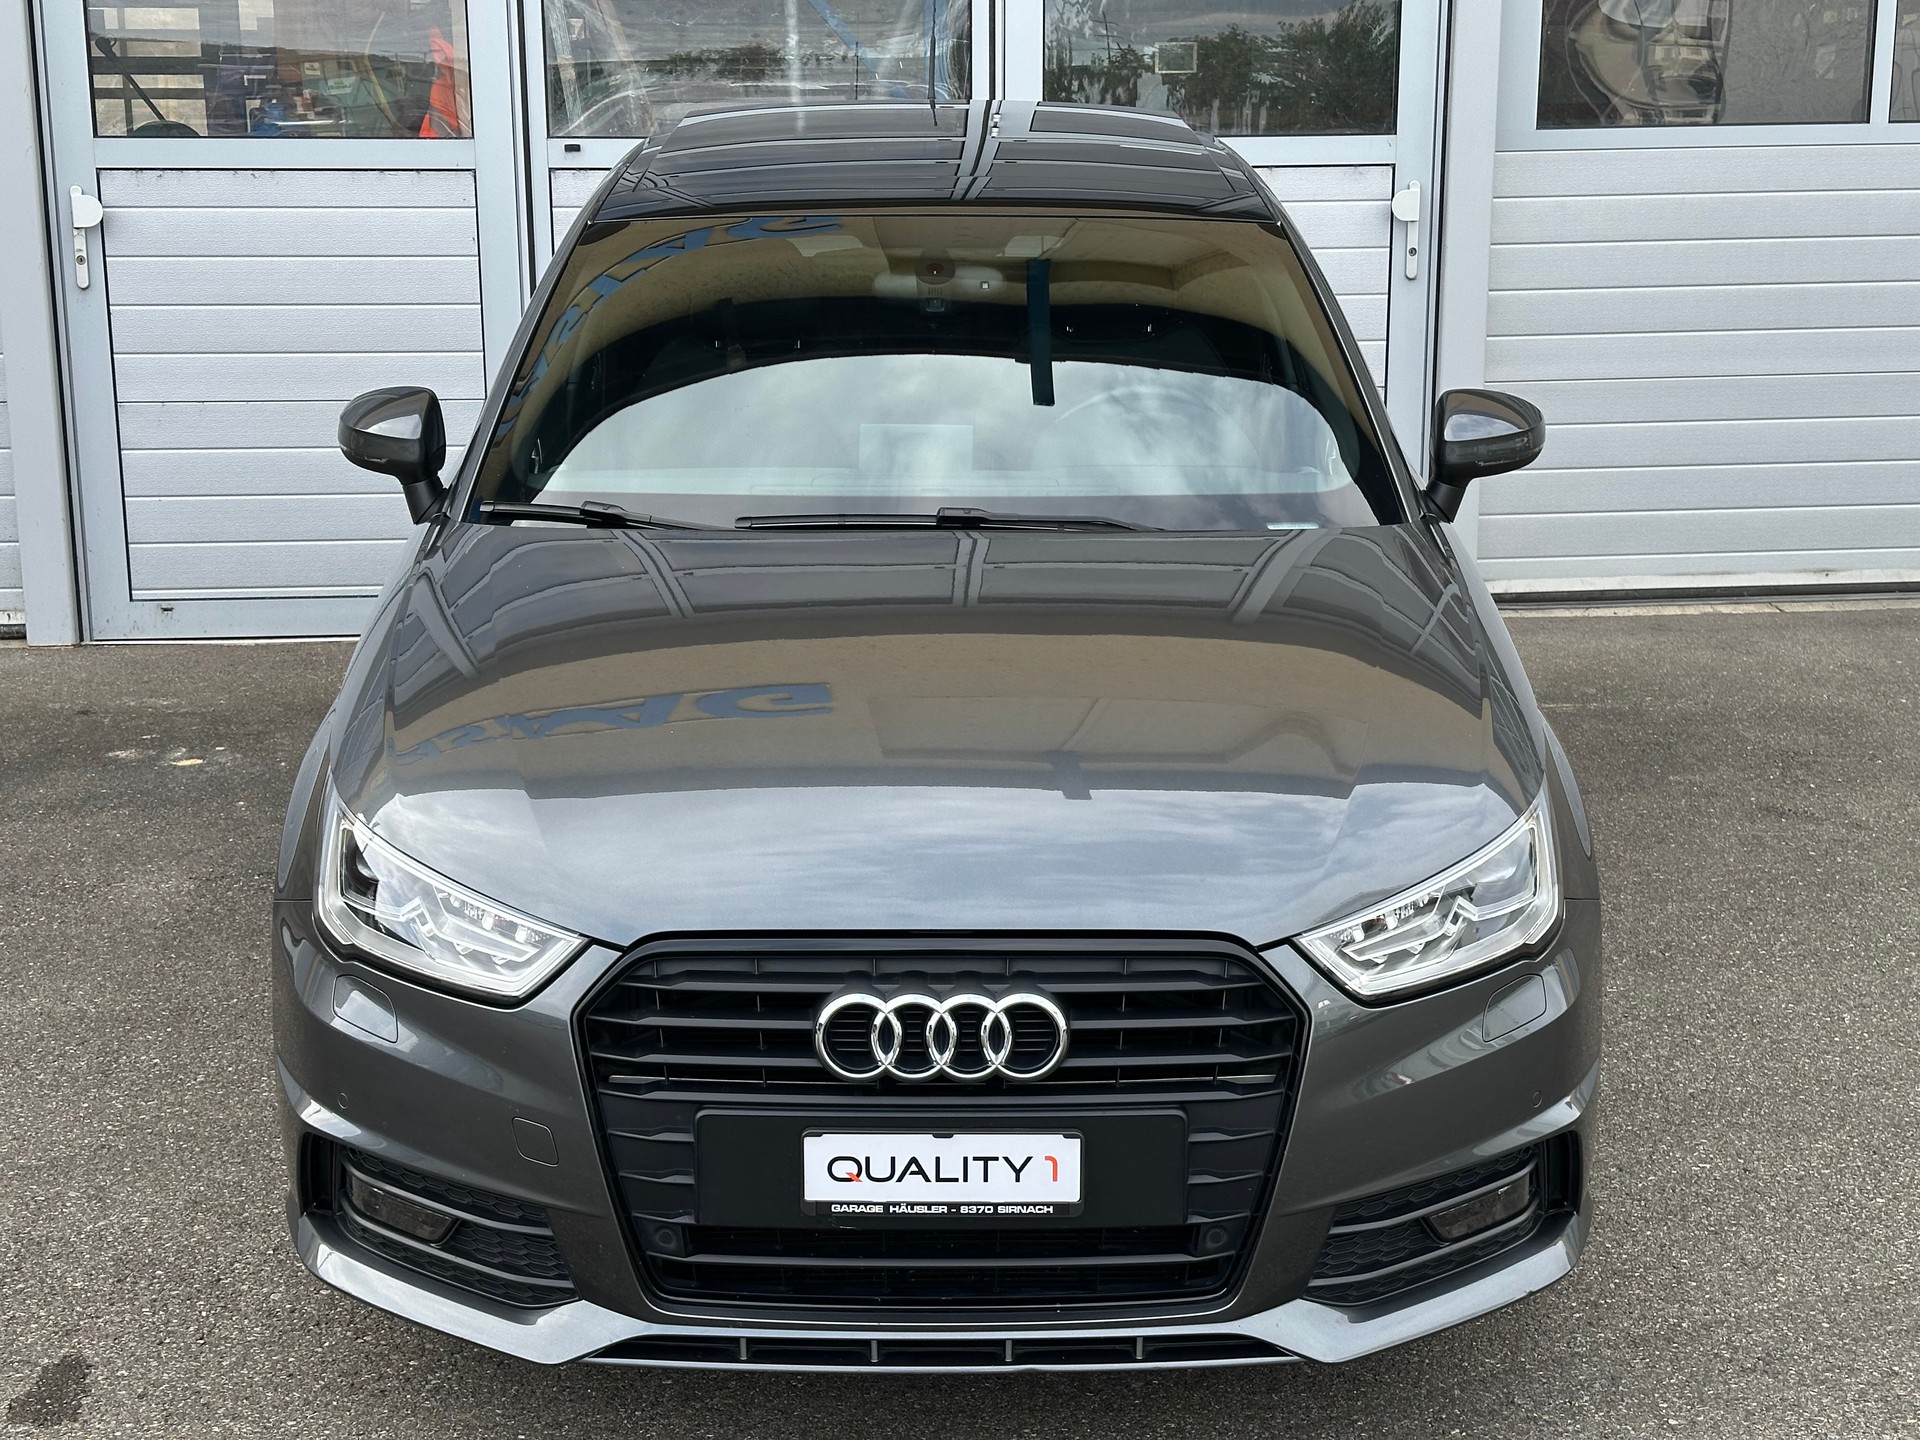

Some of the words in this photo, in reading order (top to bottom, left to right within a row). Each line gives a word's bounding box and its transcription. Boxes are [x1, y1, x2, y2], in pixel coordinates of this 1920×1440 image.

[827, 1156, 1034, 1183] QUALITY
[1044, 1156, 1058, 1183] 1
[831, 1204, 884, 1213] GARAGE
[889, 1203, 948, 1214] HÄUSLER
[960, 1205, 994, 1214] 8370
[997, 1205, 1054, 1214] SIRNACH
